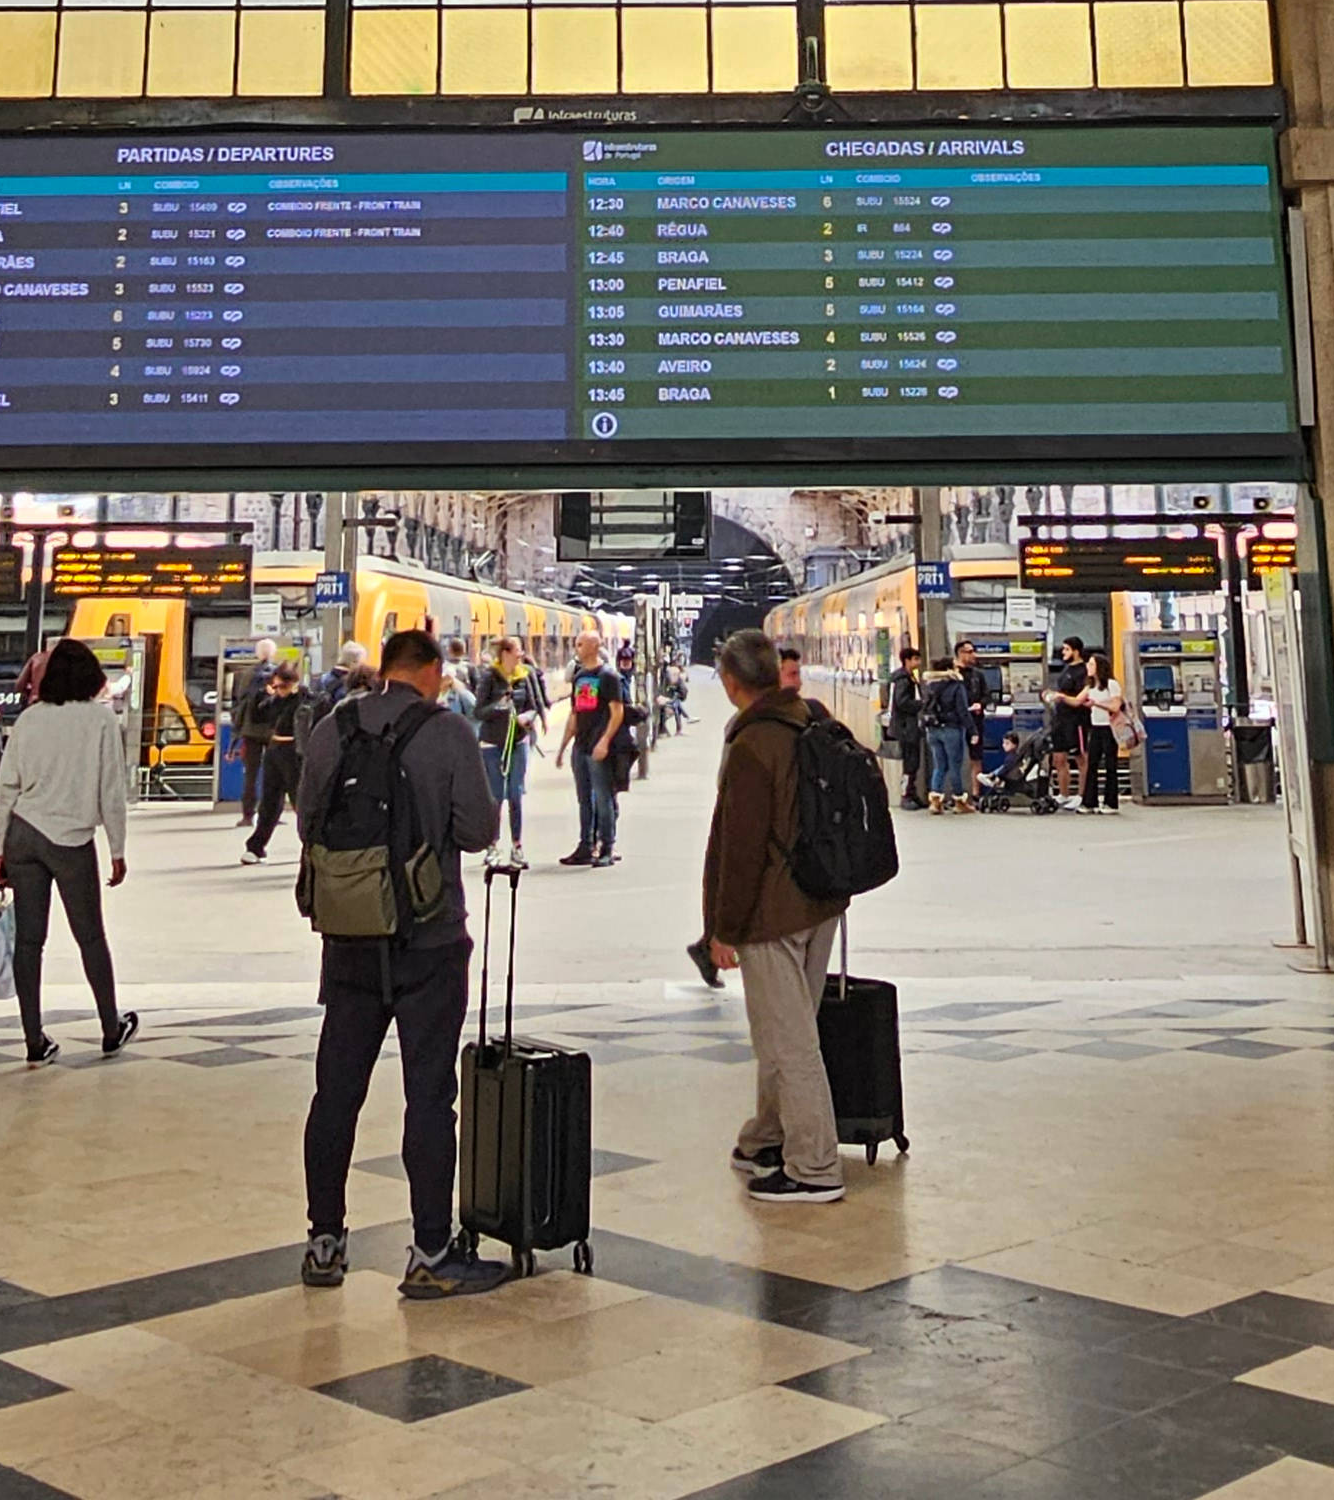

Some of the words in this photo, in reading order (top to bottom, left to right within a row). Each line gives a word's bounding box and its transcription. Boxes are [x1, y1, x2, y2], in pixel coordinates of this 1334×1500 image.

[826, 142, 925, 156] CHEGADAS
[927, 142, 934, 155] /
[937, 140, 1025, 156] ARRIVALS
[117, 147, 205, 163] PARTIDAS
[206, 147, 215, 162] /
[217, 147, 334, 162] DEPARTURES
[819, 175, 833, 183] LN
[118, 202, 129, 214] 3
[314, 201, 352, 210] FRENTE
[358, 201, 392, 210] FRONT
[588, 198, 624, 210] 12:30
[657, 197, 709, 209] MARCO
[712, 197, 797, 209] CANAVESES
[117, 229, 127, 241] 2
[314, 228, 351, 237] FRENTE
[357, 228, 391, 237] FRONT
[588, 225, 624, 237] 12:40
[657, 221, 708, 236] RÉGUA
[823, 223, 832, 235] 2
[116, 256, 126, 268] 2
[588, 252, 624, 264] 12:45
[657, 251, 709, 264] BRAGA
[824, 250, 833, 262] 3
[3, 283, 89, 296] CANAVESES
[115, 283, 124, 295] 3
[588, 279, 624, 291] 13:00
[658, 278, 727, 291] PENAFIEL
[588, 305, 625, 319] 13:05
[658, 304, 743, 318] GUIMARÃES
[826, 304, 835, 316] 5
[112, 337, 122, 350] 5
[588, 334, 625, 346] 13:30
[658, 333, 711, 345] MARCO
[714, 332, 800, 345] CANAVESES
[825, 331, 836, 343] 4
[110, 365, 120, 377] 4
[588, 361, 625, 373] 13:40
[658, 360, 712, 373] AVEIRO
[826, 359, 836, 371] 2
[109, 393, 118, 405] 3
[588, 388, 625, 401] 13:45
[658, 388, 711, 400] BRAGA
[828, 386, 836, 399] 1
[917, 573, 944, 586] PRT1
[316, 582, 343, 595] PRT1
